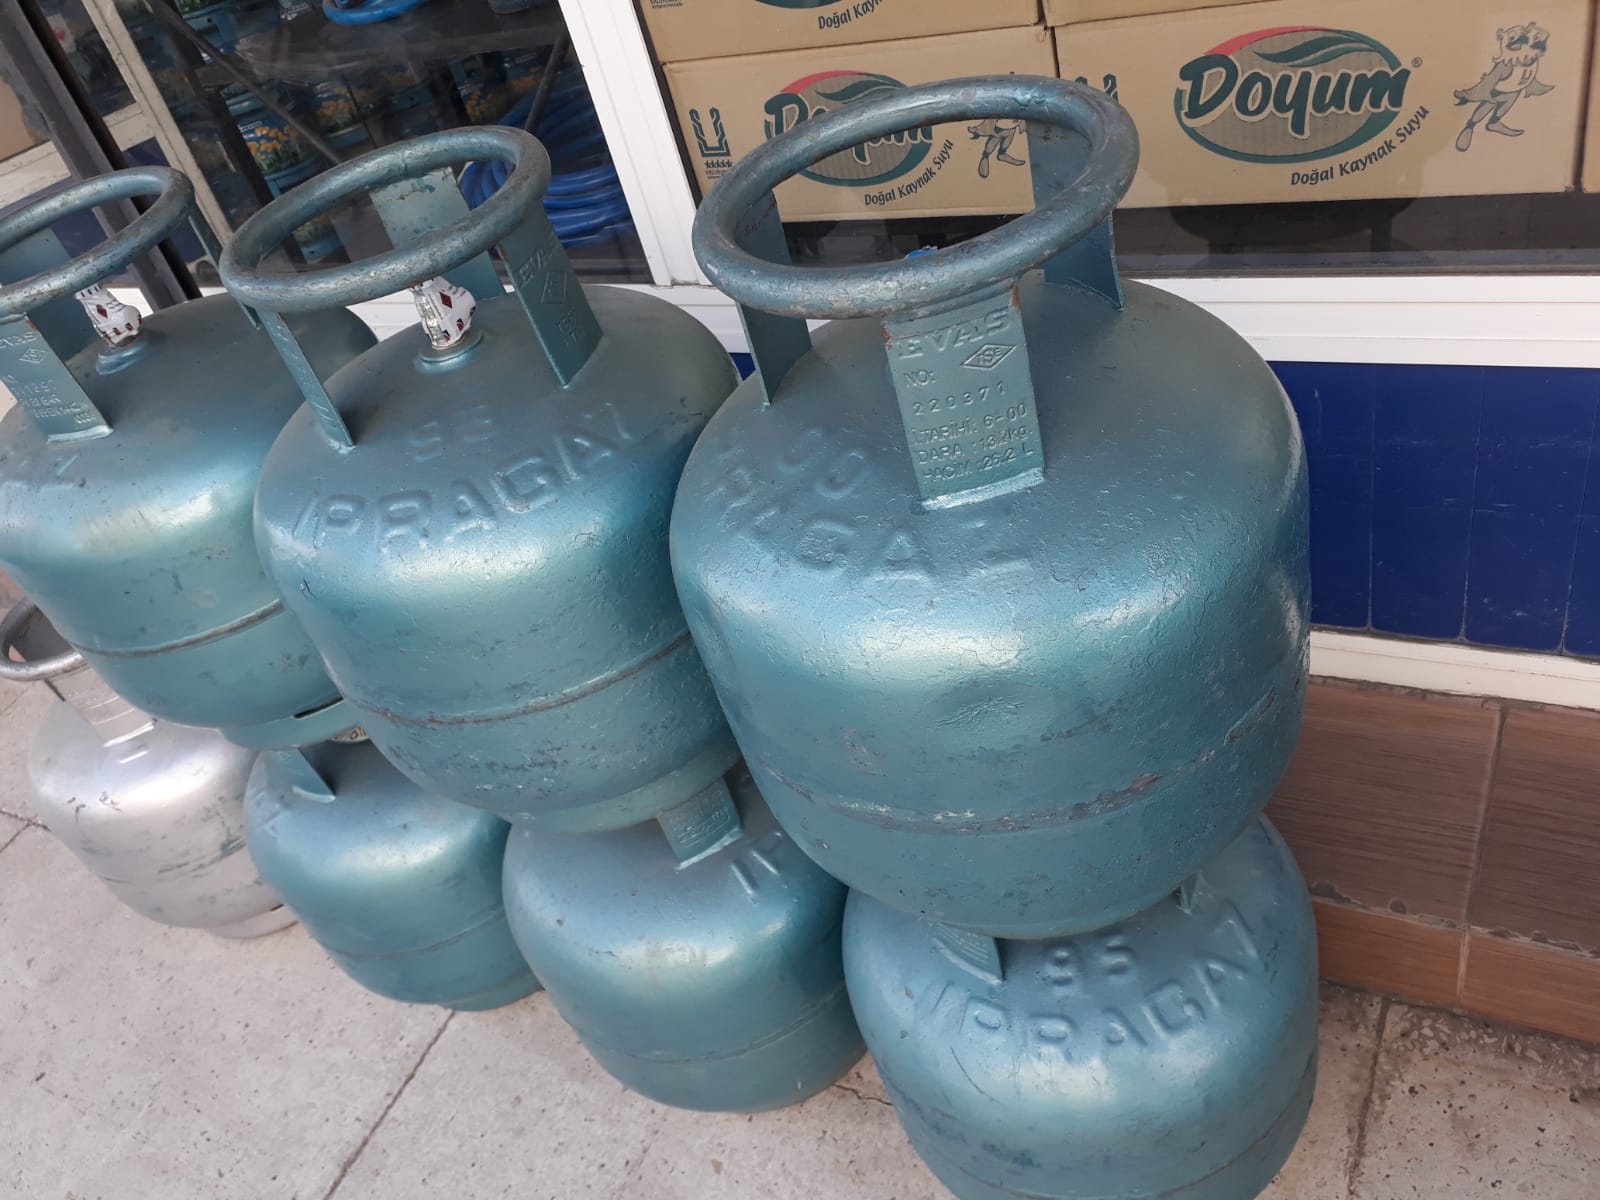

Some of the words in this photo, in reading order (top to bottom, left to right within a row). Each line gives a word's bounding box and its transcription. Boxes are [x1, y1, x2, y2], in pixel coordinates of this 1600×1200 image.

[818, 9, 852, 29] Doğal
[1179, 53, 1411, 137] Doyum
[864, 187, 896, 206] Doğal
[899, 167, 937, 198] Kaynak
[934, 138, 955, 171] Suyu
[1290, 166, 1334, 186] Doğal
[1339, 140, 1397, 177] Kaynak
[1395, 105, 1430, 143] Suyu
